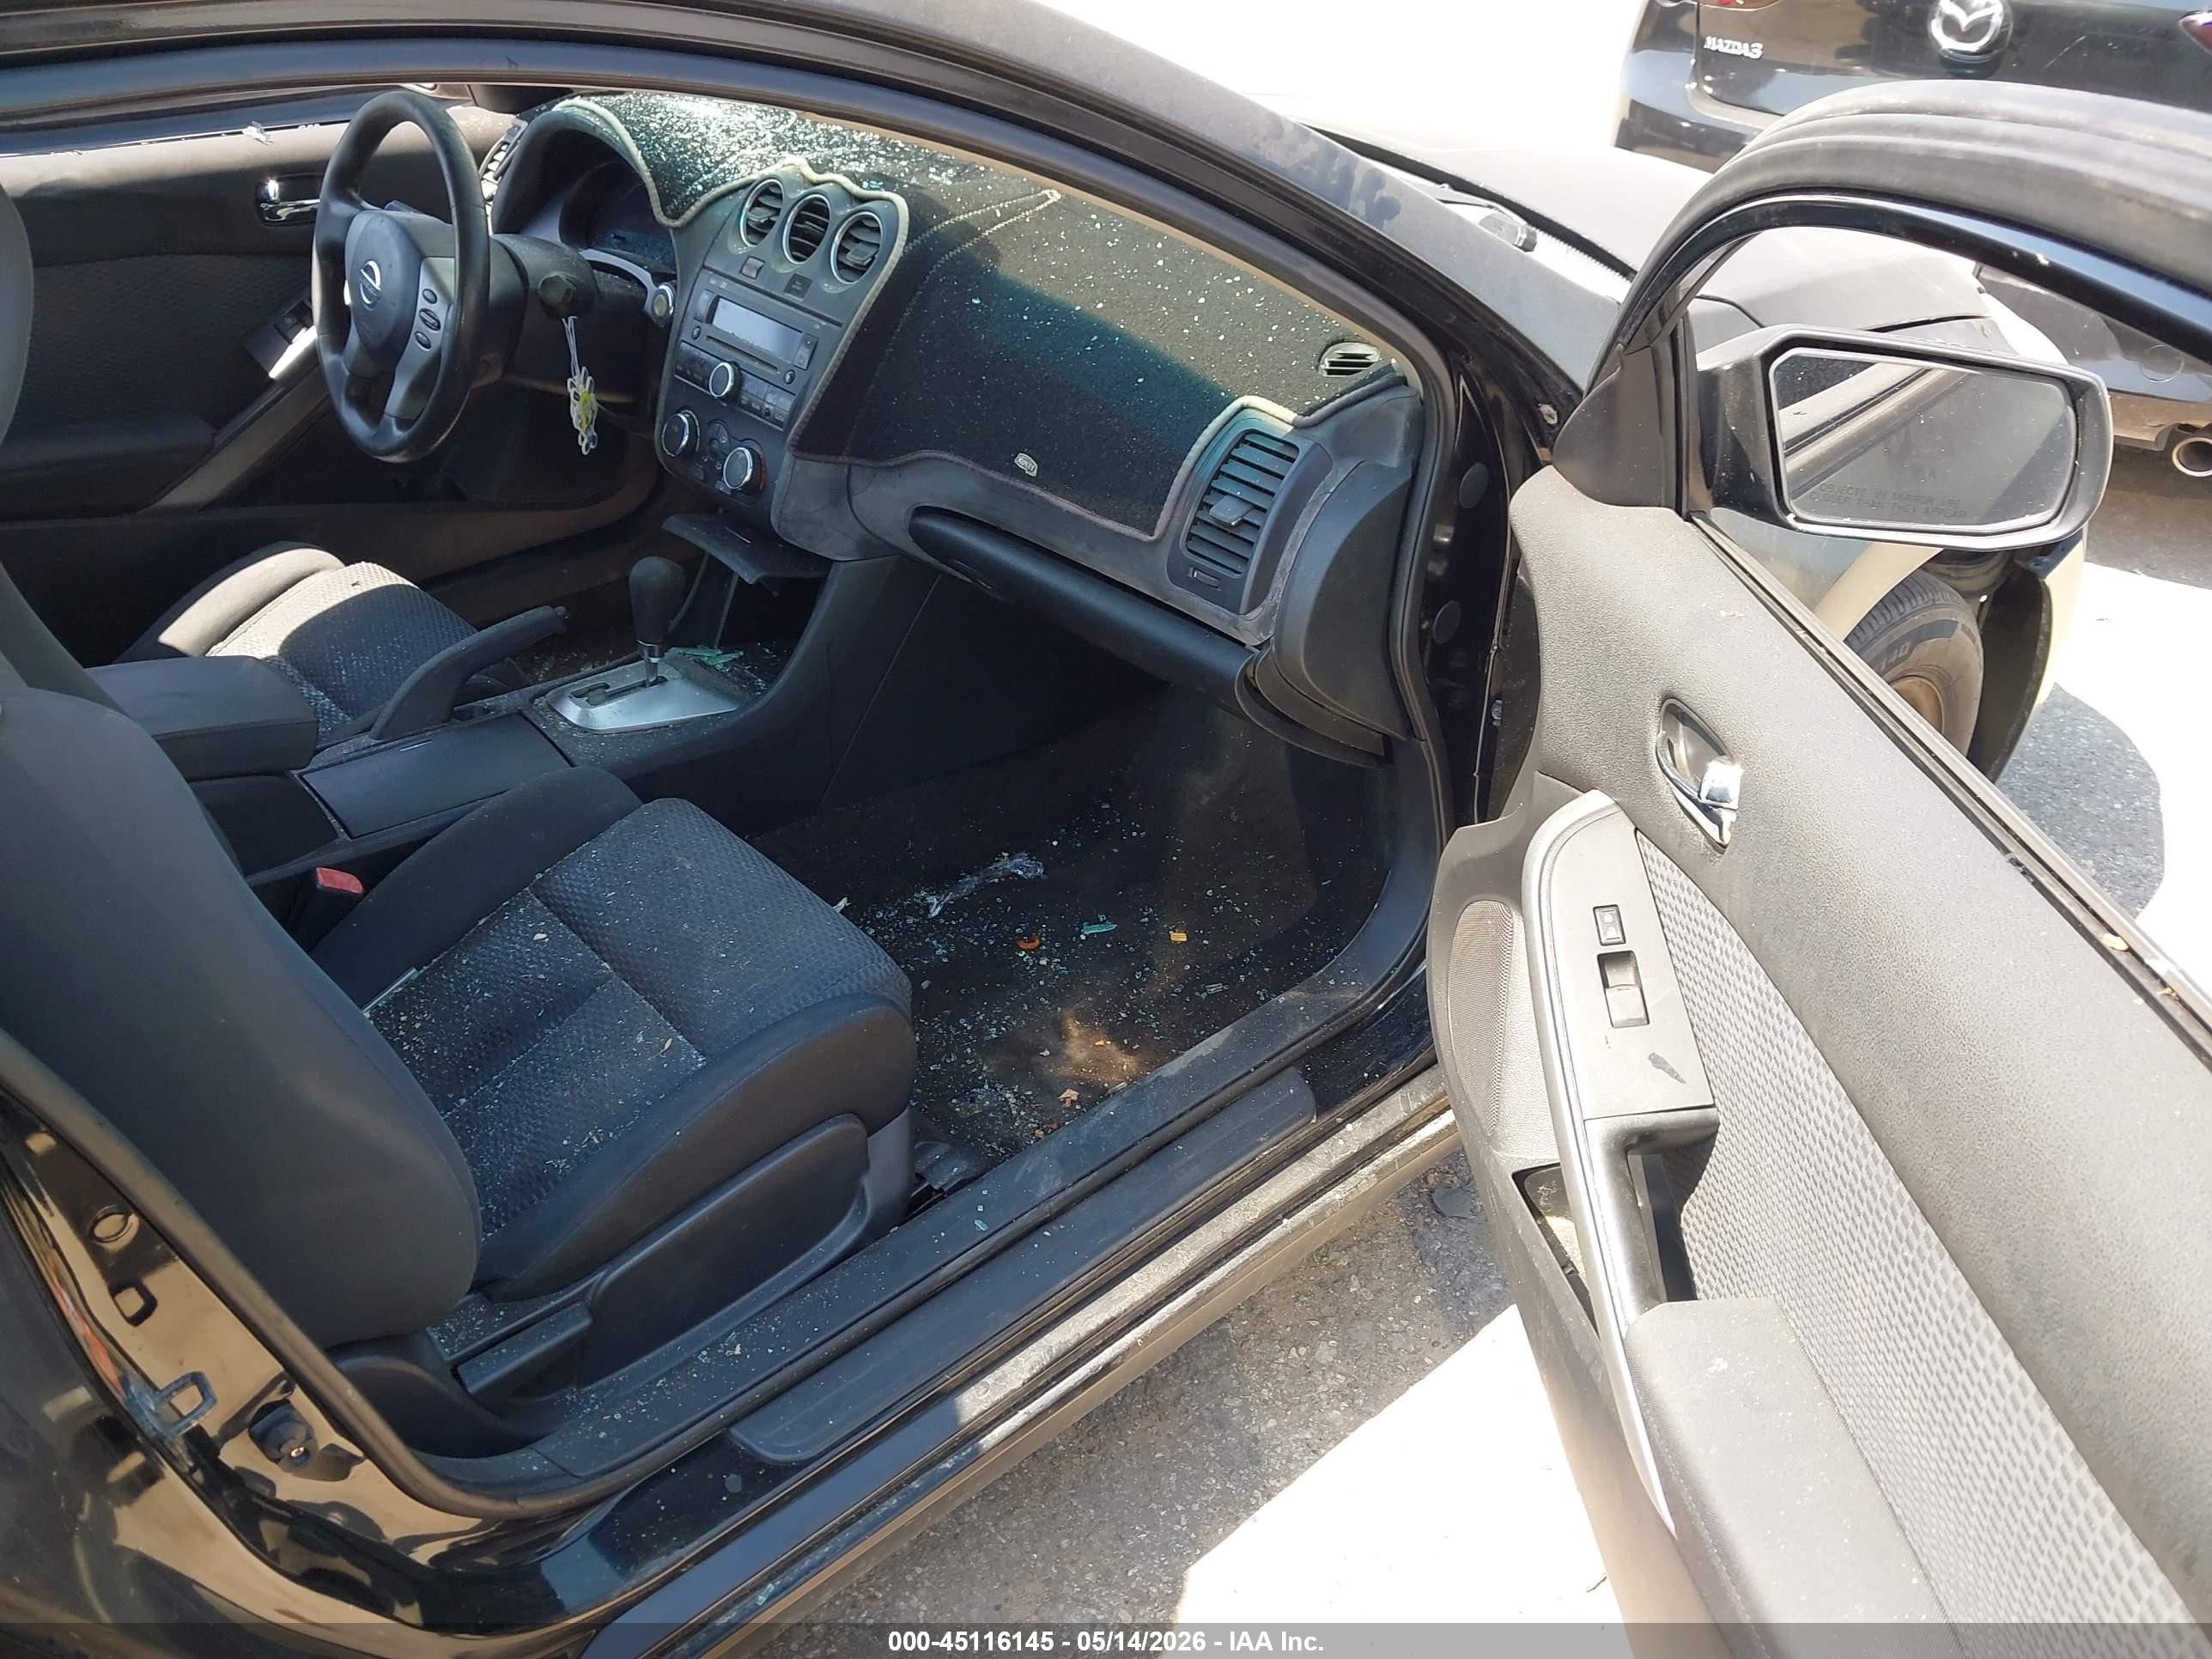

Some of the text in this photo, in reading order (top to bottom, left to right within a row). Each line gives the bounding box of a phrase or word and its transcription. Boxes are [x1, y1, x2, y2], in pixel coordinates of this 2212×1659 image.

[1703, 36, 1764, 58] MAZDA3
[1808, 491, 1852, 505] CLOSER
[1923, 507, 1968, 519] APPEAR
[1819, 482, 1868, 498] OBJECTS
[1893, 492, 1935, 506] MIRROR
